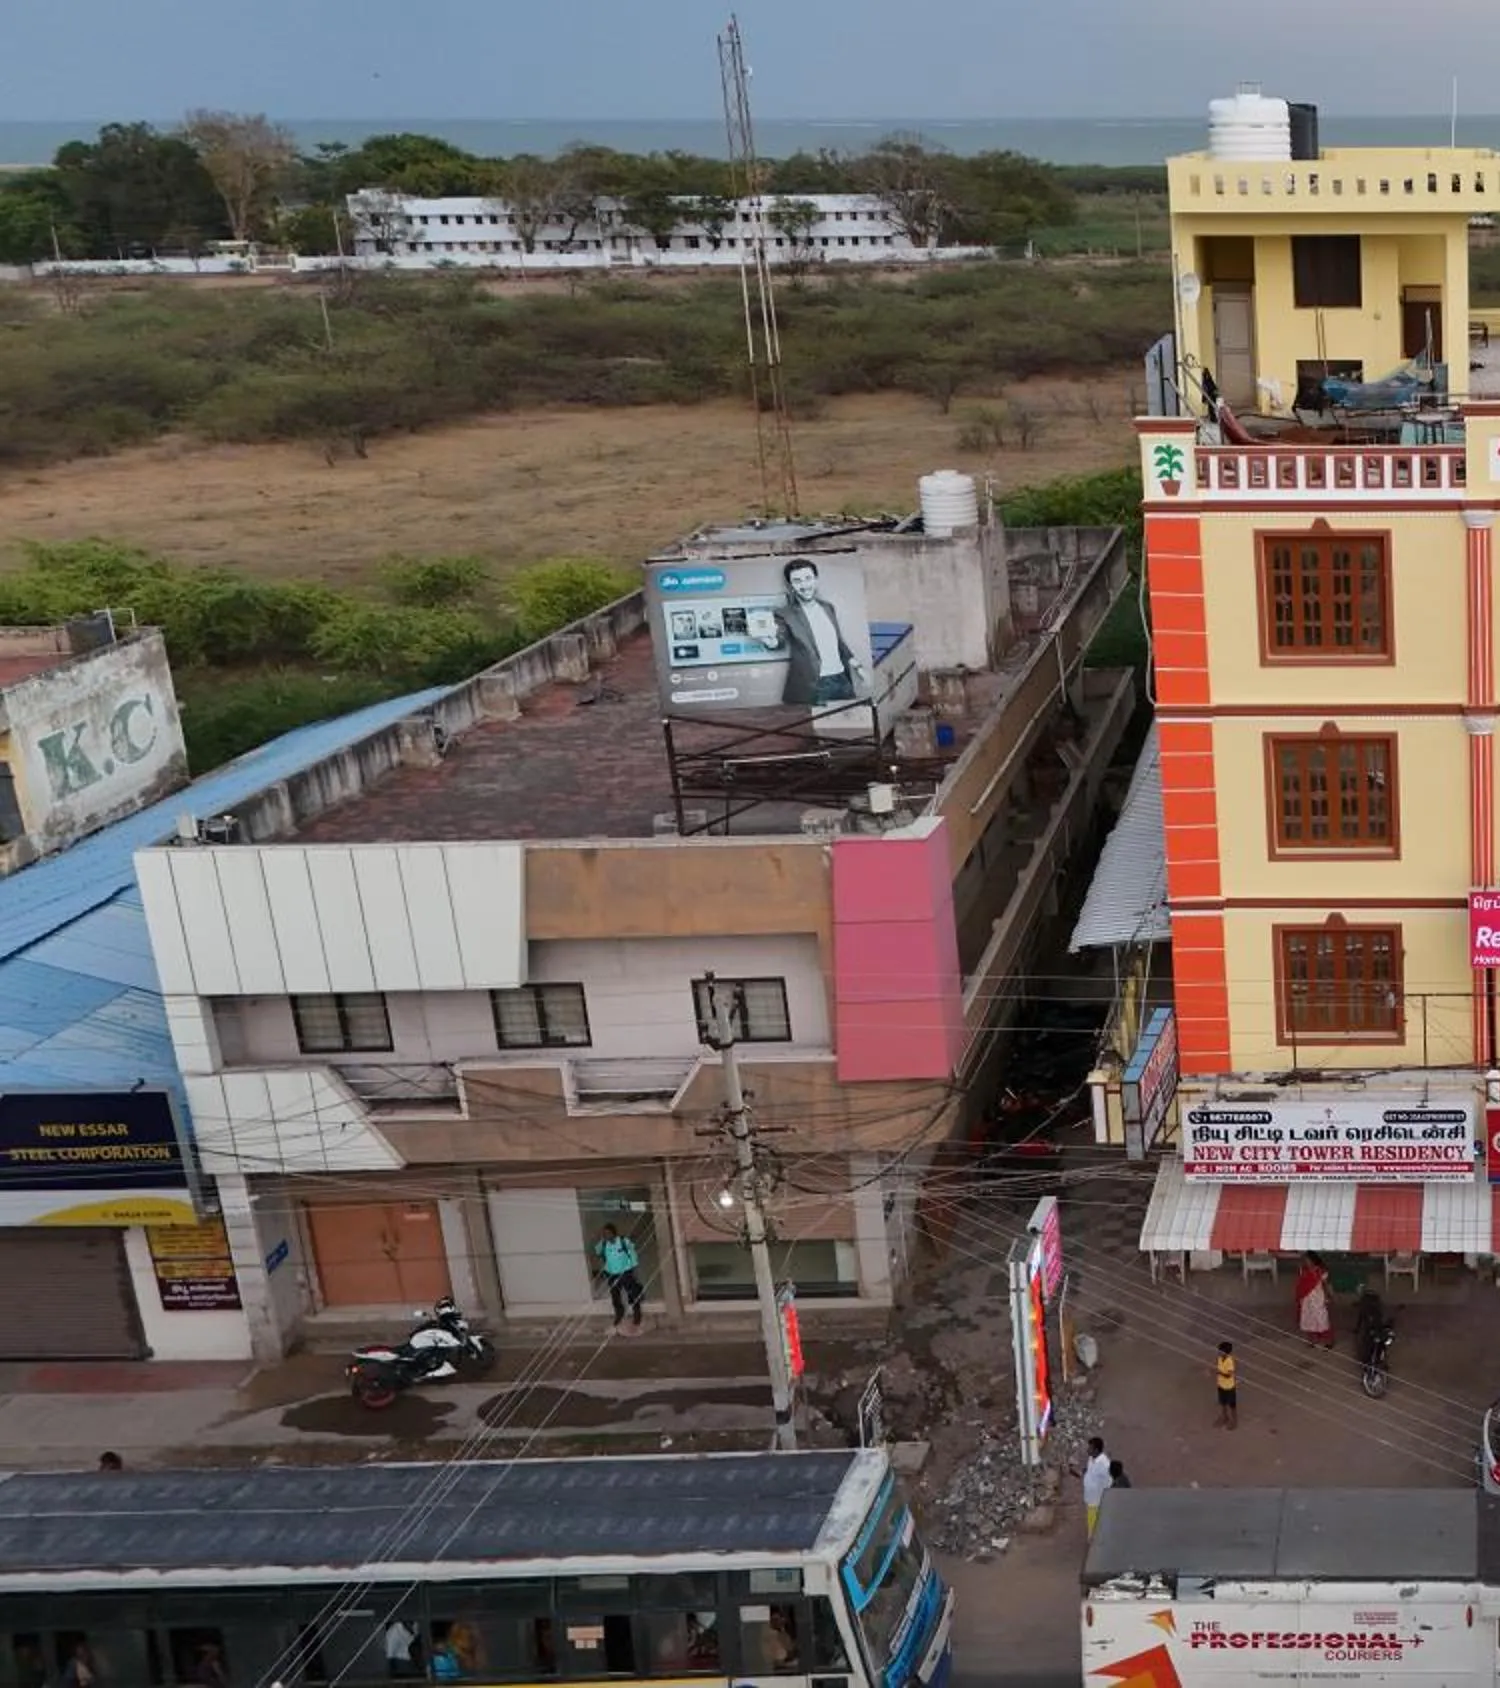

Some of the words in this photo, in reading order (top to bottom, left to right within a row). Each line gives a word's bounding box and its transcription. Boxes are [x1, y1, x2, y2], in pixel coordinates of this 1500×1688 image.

[40, 1123, 75, 1137] NEW
[79, 1123, 129, 1136] ESSAR
[1235, 1126, 1284, 1143] சிட்டி
[1289, 1125, 1338, 1140] டவர்
[10, 1147, 57, 1161] STEEL
[58, 1145, 171, 1161] CORPORATION
[1192, 1146, 1234, 1160] NEW
[1240, 1146, 1282, 1160] CITY
[1288, 1146, 1354, 1160] TOWER
[1360, 1145, 1467, 1160] RESIDENCY
[1258, 1163, 1297, 1172] ROOMS
[1193, 1621, 1221, 1631] THE
[1191, 1632, 1403, 1649] PROFESSIONAL
[1324, 1650, 1403, 1661] COURIERS
